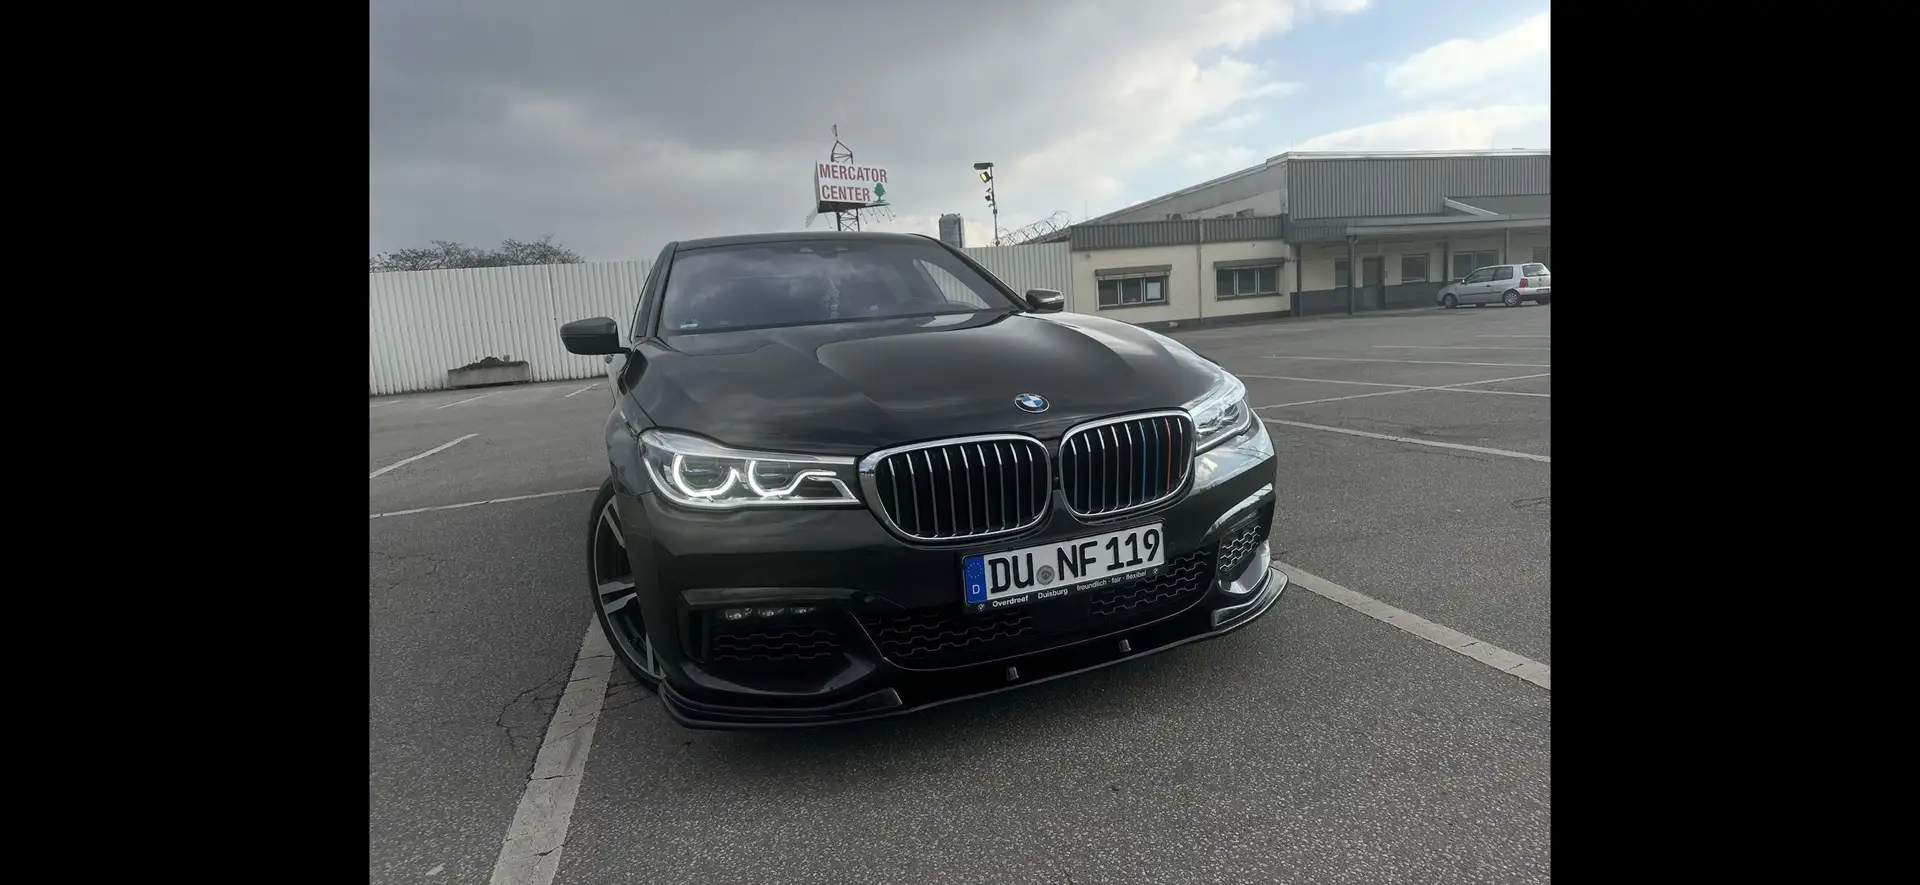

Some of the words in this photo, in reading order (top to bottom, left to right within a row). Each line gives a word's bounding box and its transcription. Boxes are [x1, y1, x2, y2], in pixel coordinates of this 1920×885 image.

[819, 164, 888, 183] MERCATOR
[822, 185, 871, 201] CENTER
[988, 553, 1035, 594] DU
[1057, 541, 1098, 581] NF
[1105, 529, 1160, 571] 119
[972, 585, 980, 595] D
[1037, 588, 1068, 599] Duisburg
[1076, 580, 1107, 591] freundlich
[1111, 576, 1121, 584] fair
[1125, 570, 1147, 580] flexibel
